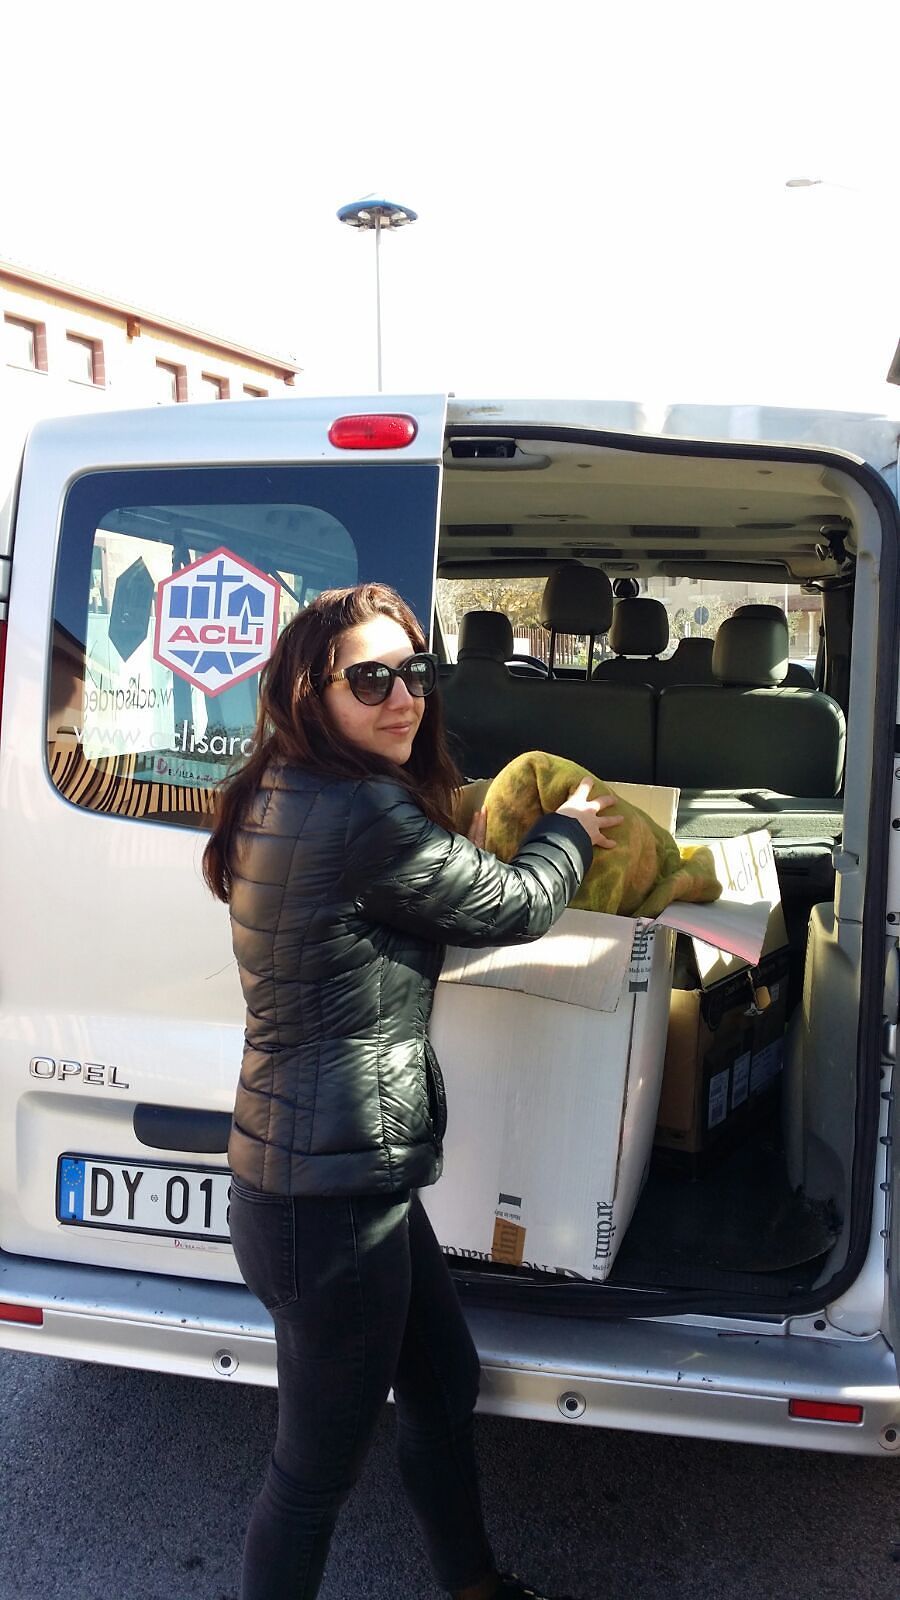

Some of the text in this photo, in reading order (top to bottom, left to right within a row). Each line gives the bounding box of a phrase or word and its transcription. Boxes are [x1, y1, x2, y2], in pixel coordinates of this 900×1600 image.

[167, 624, 264, 645] ACLI
[29, 1056, 130, 1090] OPEL
[90, 1167, 232, 1228] DY 01
